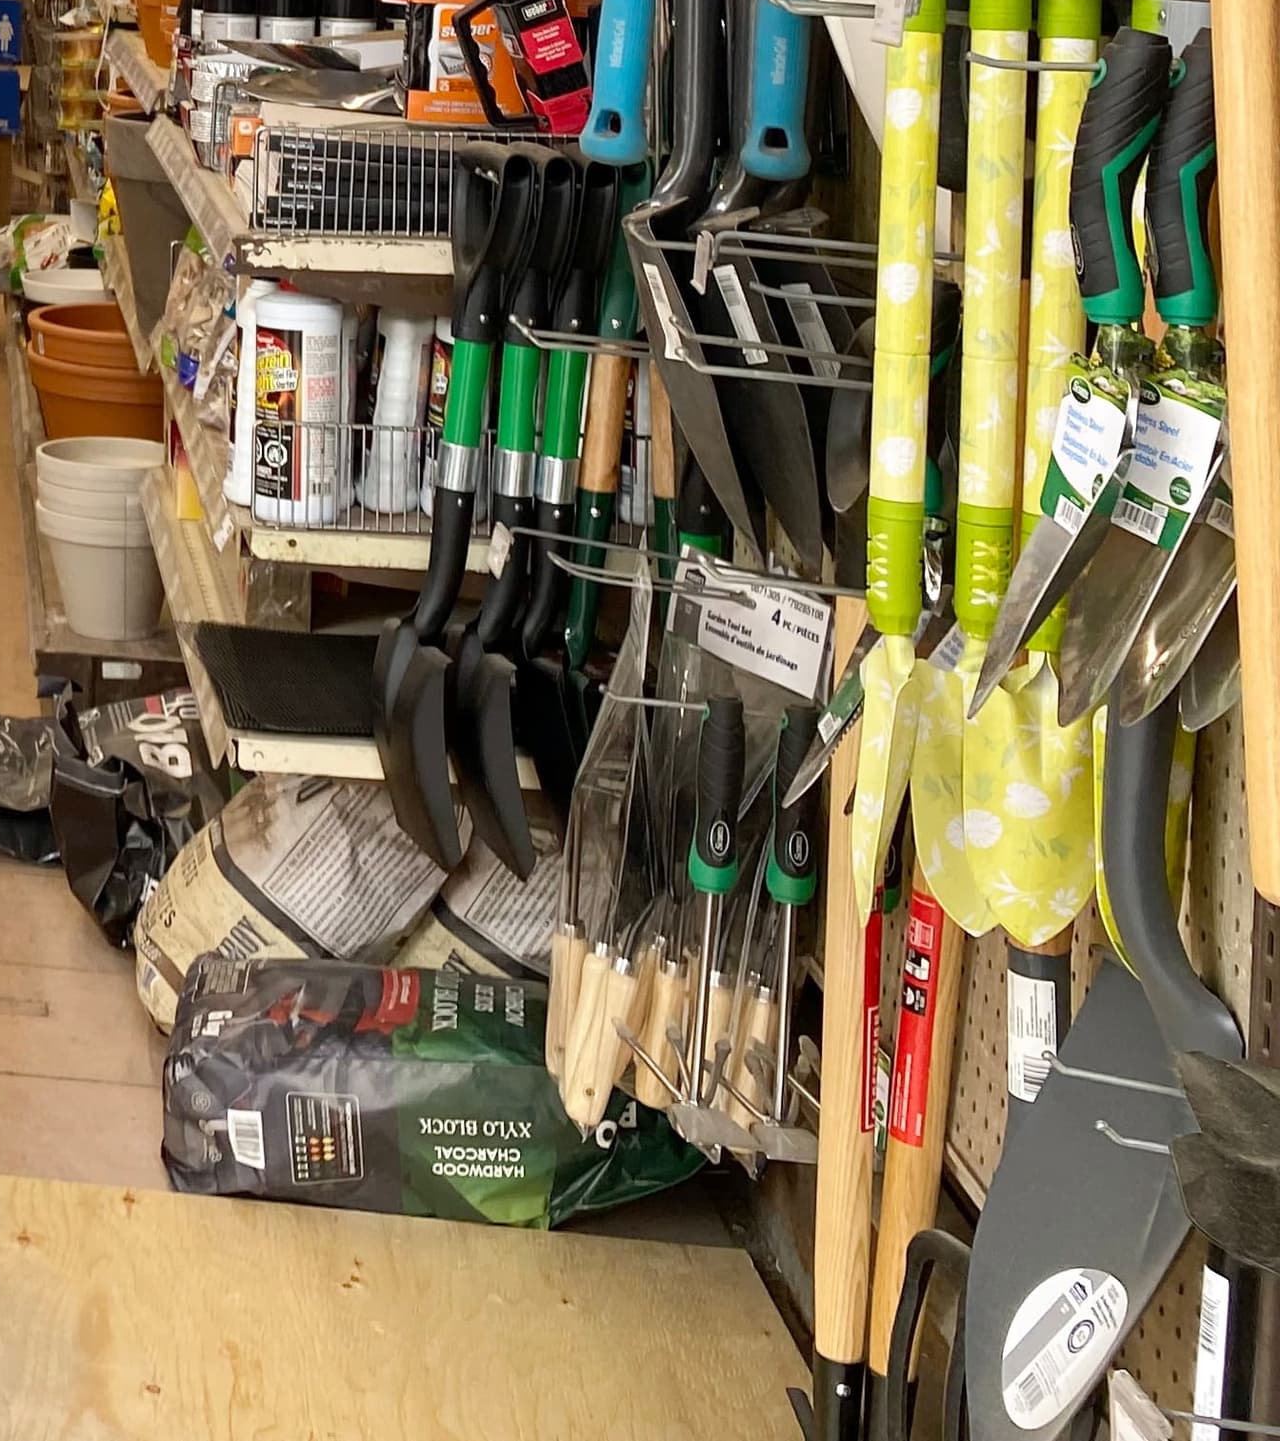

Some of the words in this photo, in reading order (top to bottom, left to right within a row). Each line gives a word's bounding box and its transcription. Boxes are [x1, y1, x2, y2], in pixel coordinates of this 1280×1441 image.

[771, 608, 782, 627] 4
[418, 1117, 478, 1136] BLOCK
[483, 1119, 532, 1139] XYLO
[433, 1144, 521, 1163] CHARCOAL
[432, 1162, 525, 1178] HARDWOOD
